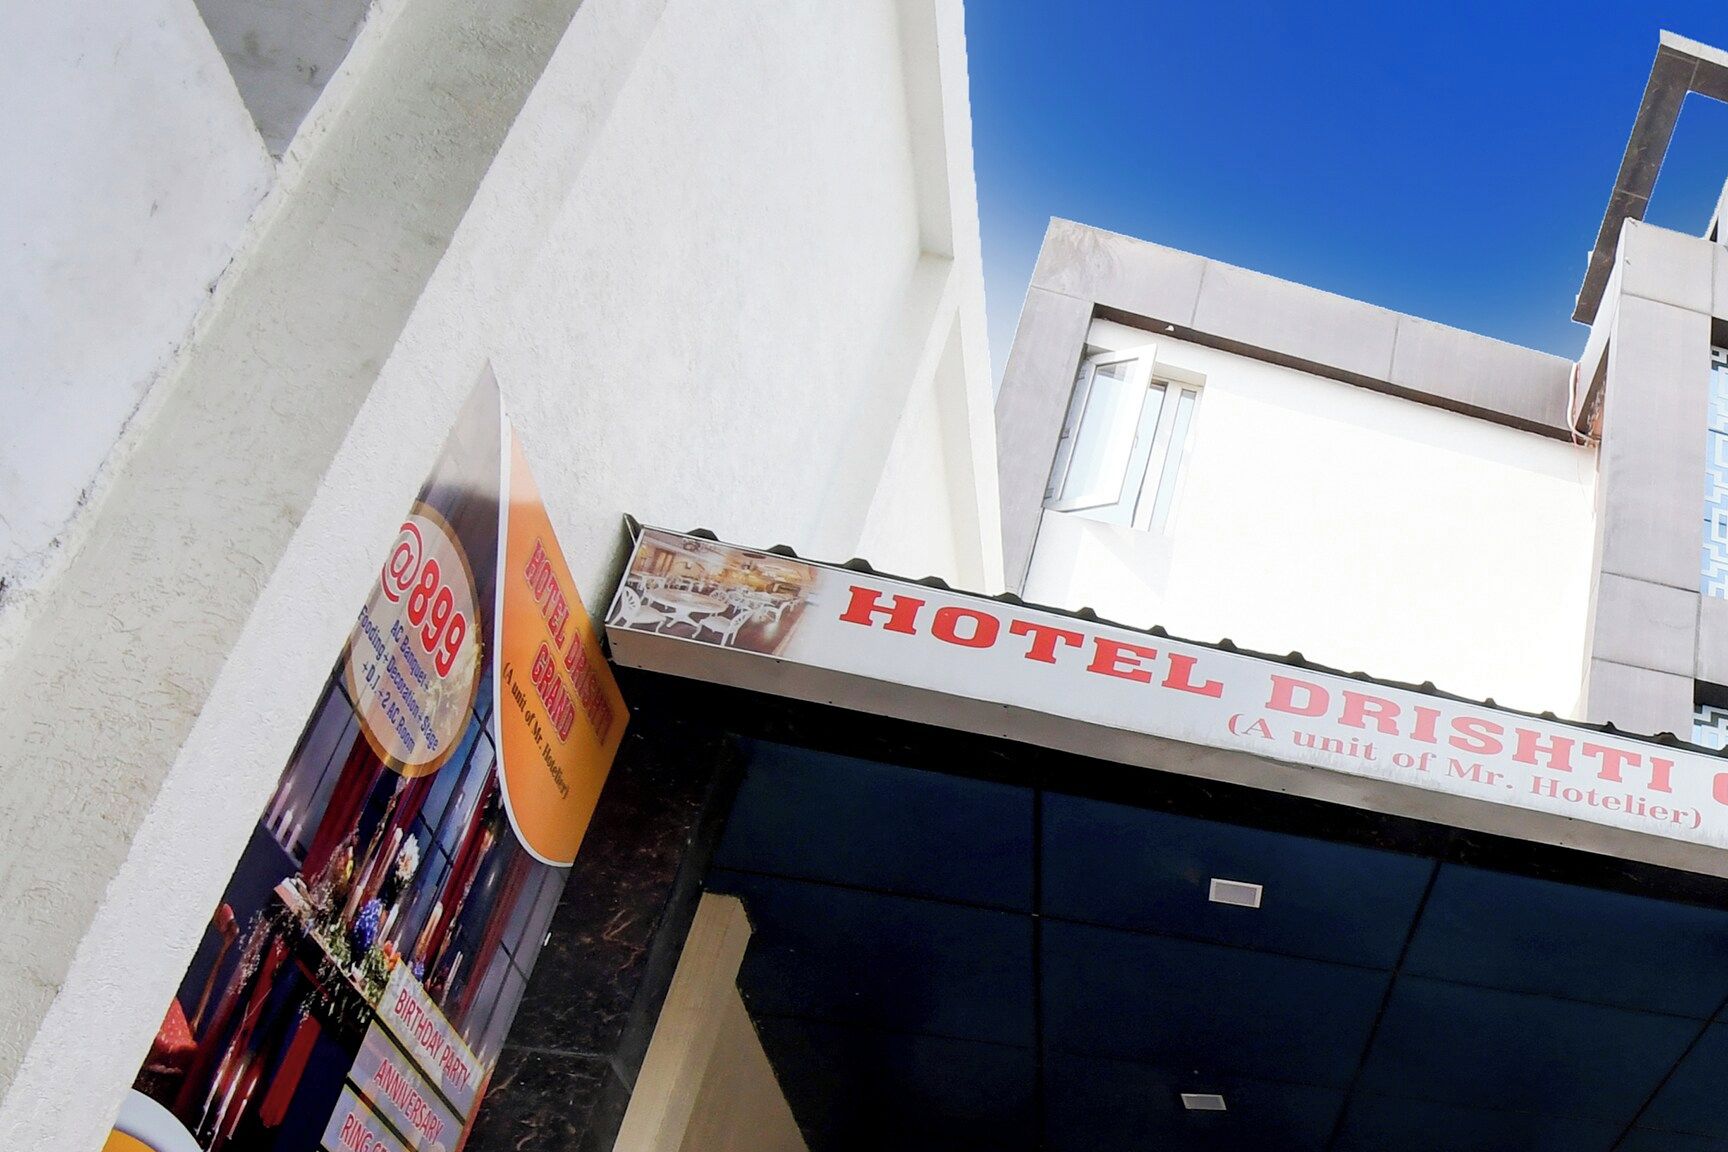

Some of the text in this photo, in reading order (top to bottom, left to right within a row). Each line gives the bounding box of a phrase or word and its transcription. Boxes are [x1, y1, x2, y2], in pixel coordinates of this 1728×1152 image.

[390, 619, 404, 643] AC
[524, 537, 570, 650] HOTEL
[387, 702, 400, 725] AC
[395, 720, 416, 754] Room
[511, 682, 527, 712] unit
[524, 709, 536, 726] of
[531, 720, 544, 750] Mr.
[531, 641, 576, 744] GRAND
[838, 584, 1224, 699] HOTEL
[1264, 673, 1675, 794] DRISHTI
[1228, 711, 1703, 830] (A unit of Mr. Hotelier)
[394, 988, 471, 1092] BIRTHDAY PARTY
[374, 1059, 446, 1146] ANNIVERSARY
